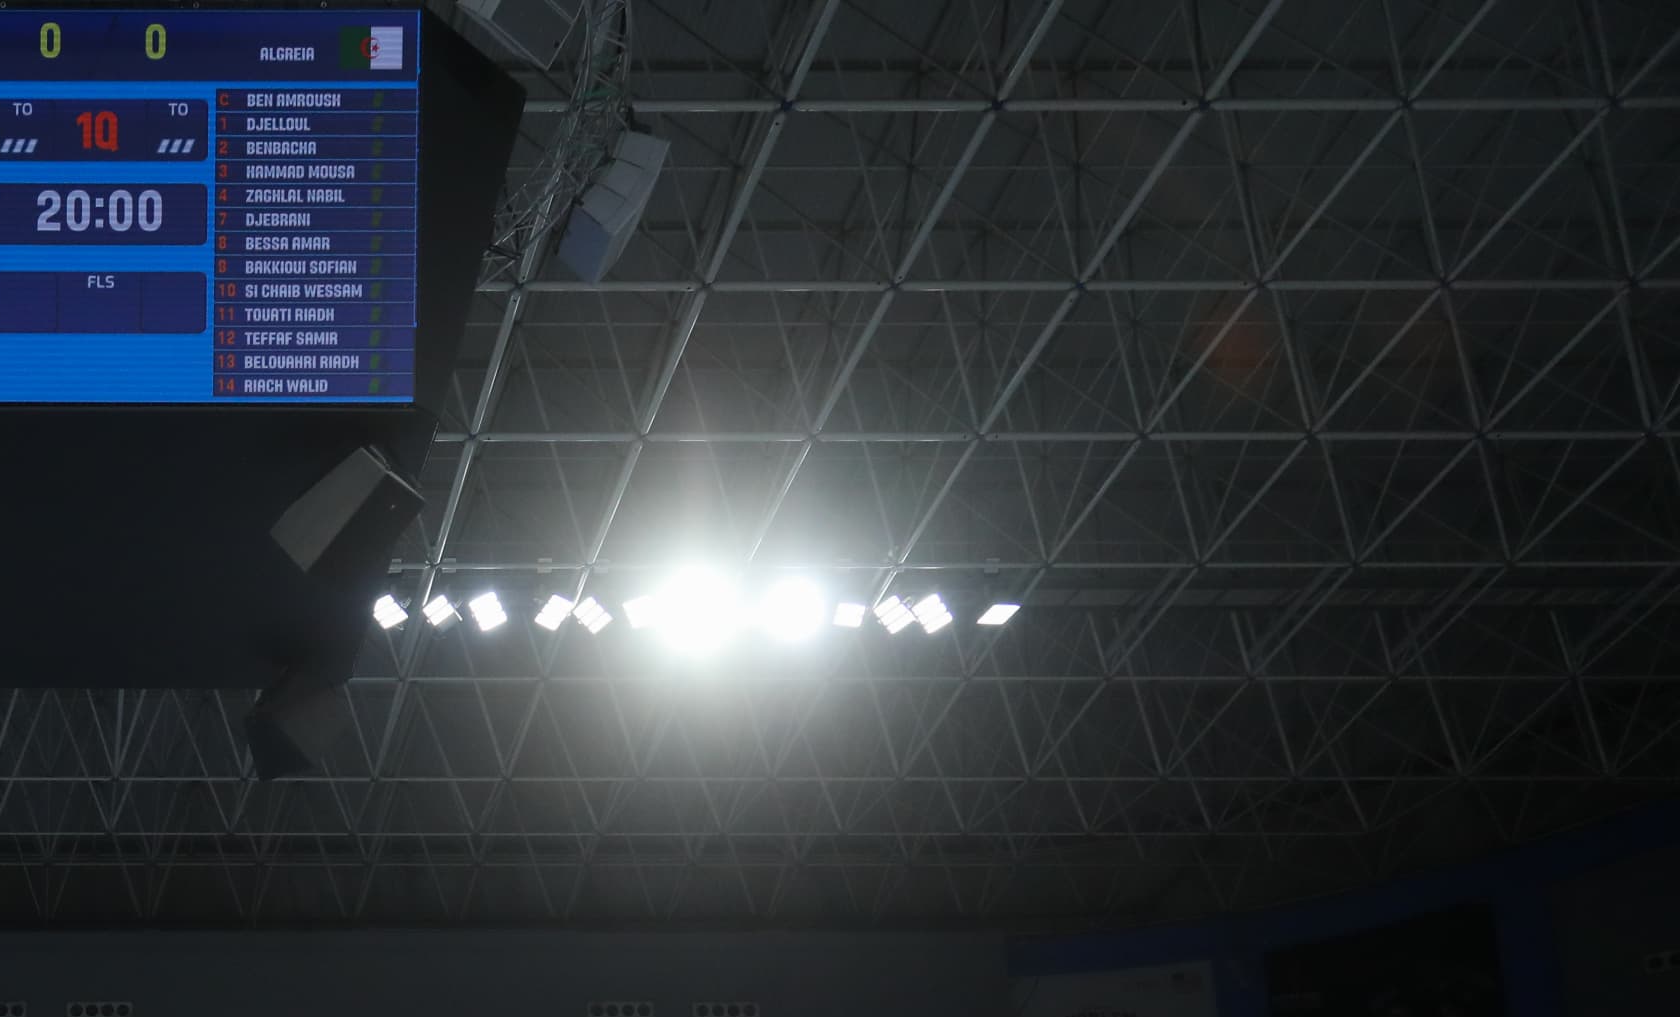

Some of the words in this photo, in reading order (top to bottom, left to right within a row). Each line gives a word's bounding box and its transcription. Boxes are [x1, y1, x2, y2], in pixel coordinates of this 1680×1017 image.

[40, 22, 61, 59] 0
[145, 24, 167, 60] 0
[259, 46, 315, 62] ALGREIA
[219, 94, 229, 107] C
[247, 94, 273, 108] BEN
[277, 94, 341, 108] AMROUSH
[12, 102, 33, 117] TO
[168, 102, 189, 117] TO
[76, 110, 118, 152] 1Q
[220, 117, 227, 130] 1
[247, 118, 311, 132] DJELLOUL
[218, 141, 228, 154] 2
[247, 142, 317, 155] BENBACHA
[218, 164, 228, 178] 3
[246, 165, 304, 178] HAMMAD
[308, 165, 355, 178] MOUSA
[218, 189, 228, 202] 4
[307, 189, 346, 202] NABIL
[37, 189, 163, 232] 20:00
[218, 212, 228, 225] 7
[246, 213, 311, 226] DJEBRANI
[245, 236, 289, 250] BESSA
[292, 236, 330, 250] AMAR
[309, 260, 357, 274] SOFIAN
[87, 276, 115, 289] FLS
[219, 284, 236, 297] 10
[245, 284, 258, 298] SI
[262, 284, 300, 298] CHAIB
[304, 284, 362, 298] WESSAM
[218, 308, 234, 321] 11
[295, 308, 334, 322] RIADH
[218, 332, 236, 345] 12
[245, 332, 293, 346] TEFFAF
[296, 332, 338, 346] SAMIR
[218, 355, 236, 368] 13
[319, 356, 359, 369] RIADH
[218, 379, 234, 392] 14
[244, 380, 283, 393] RIACH
[286, 380, 328, 393] WALID
